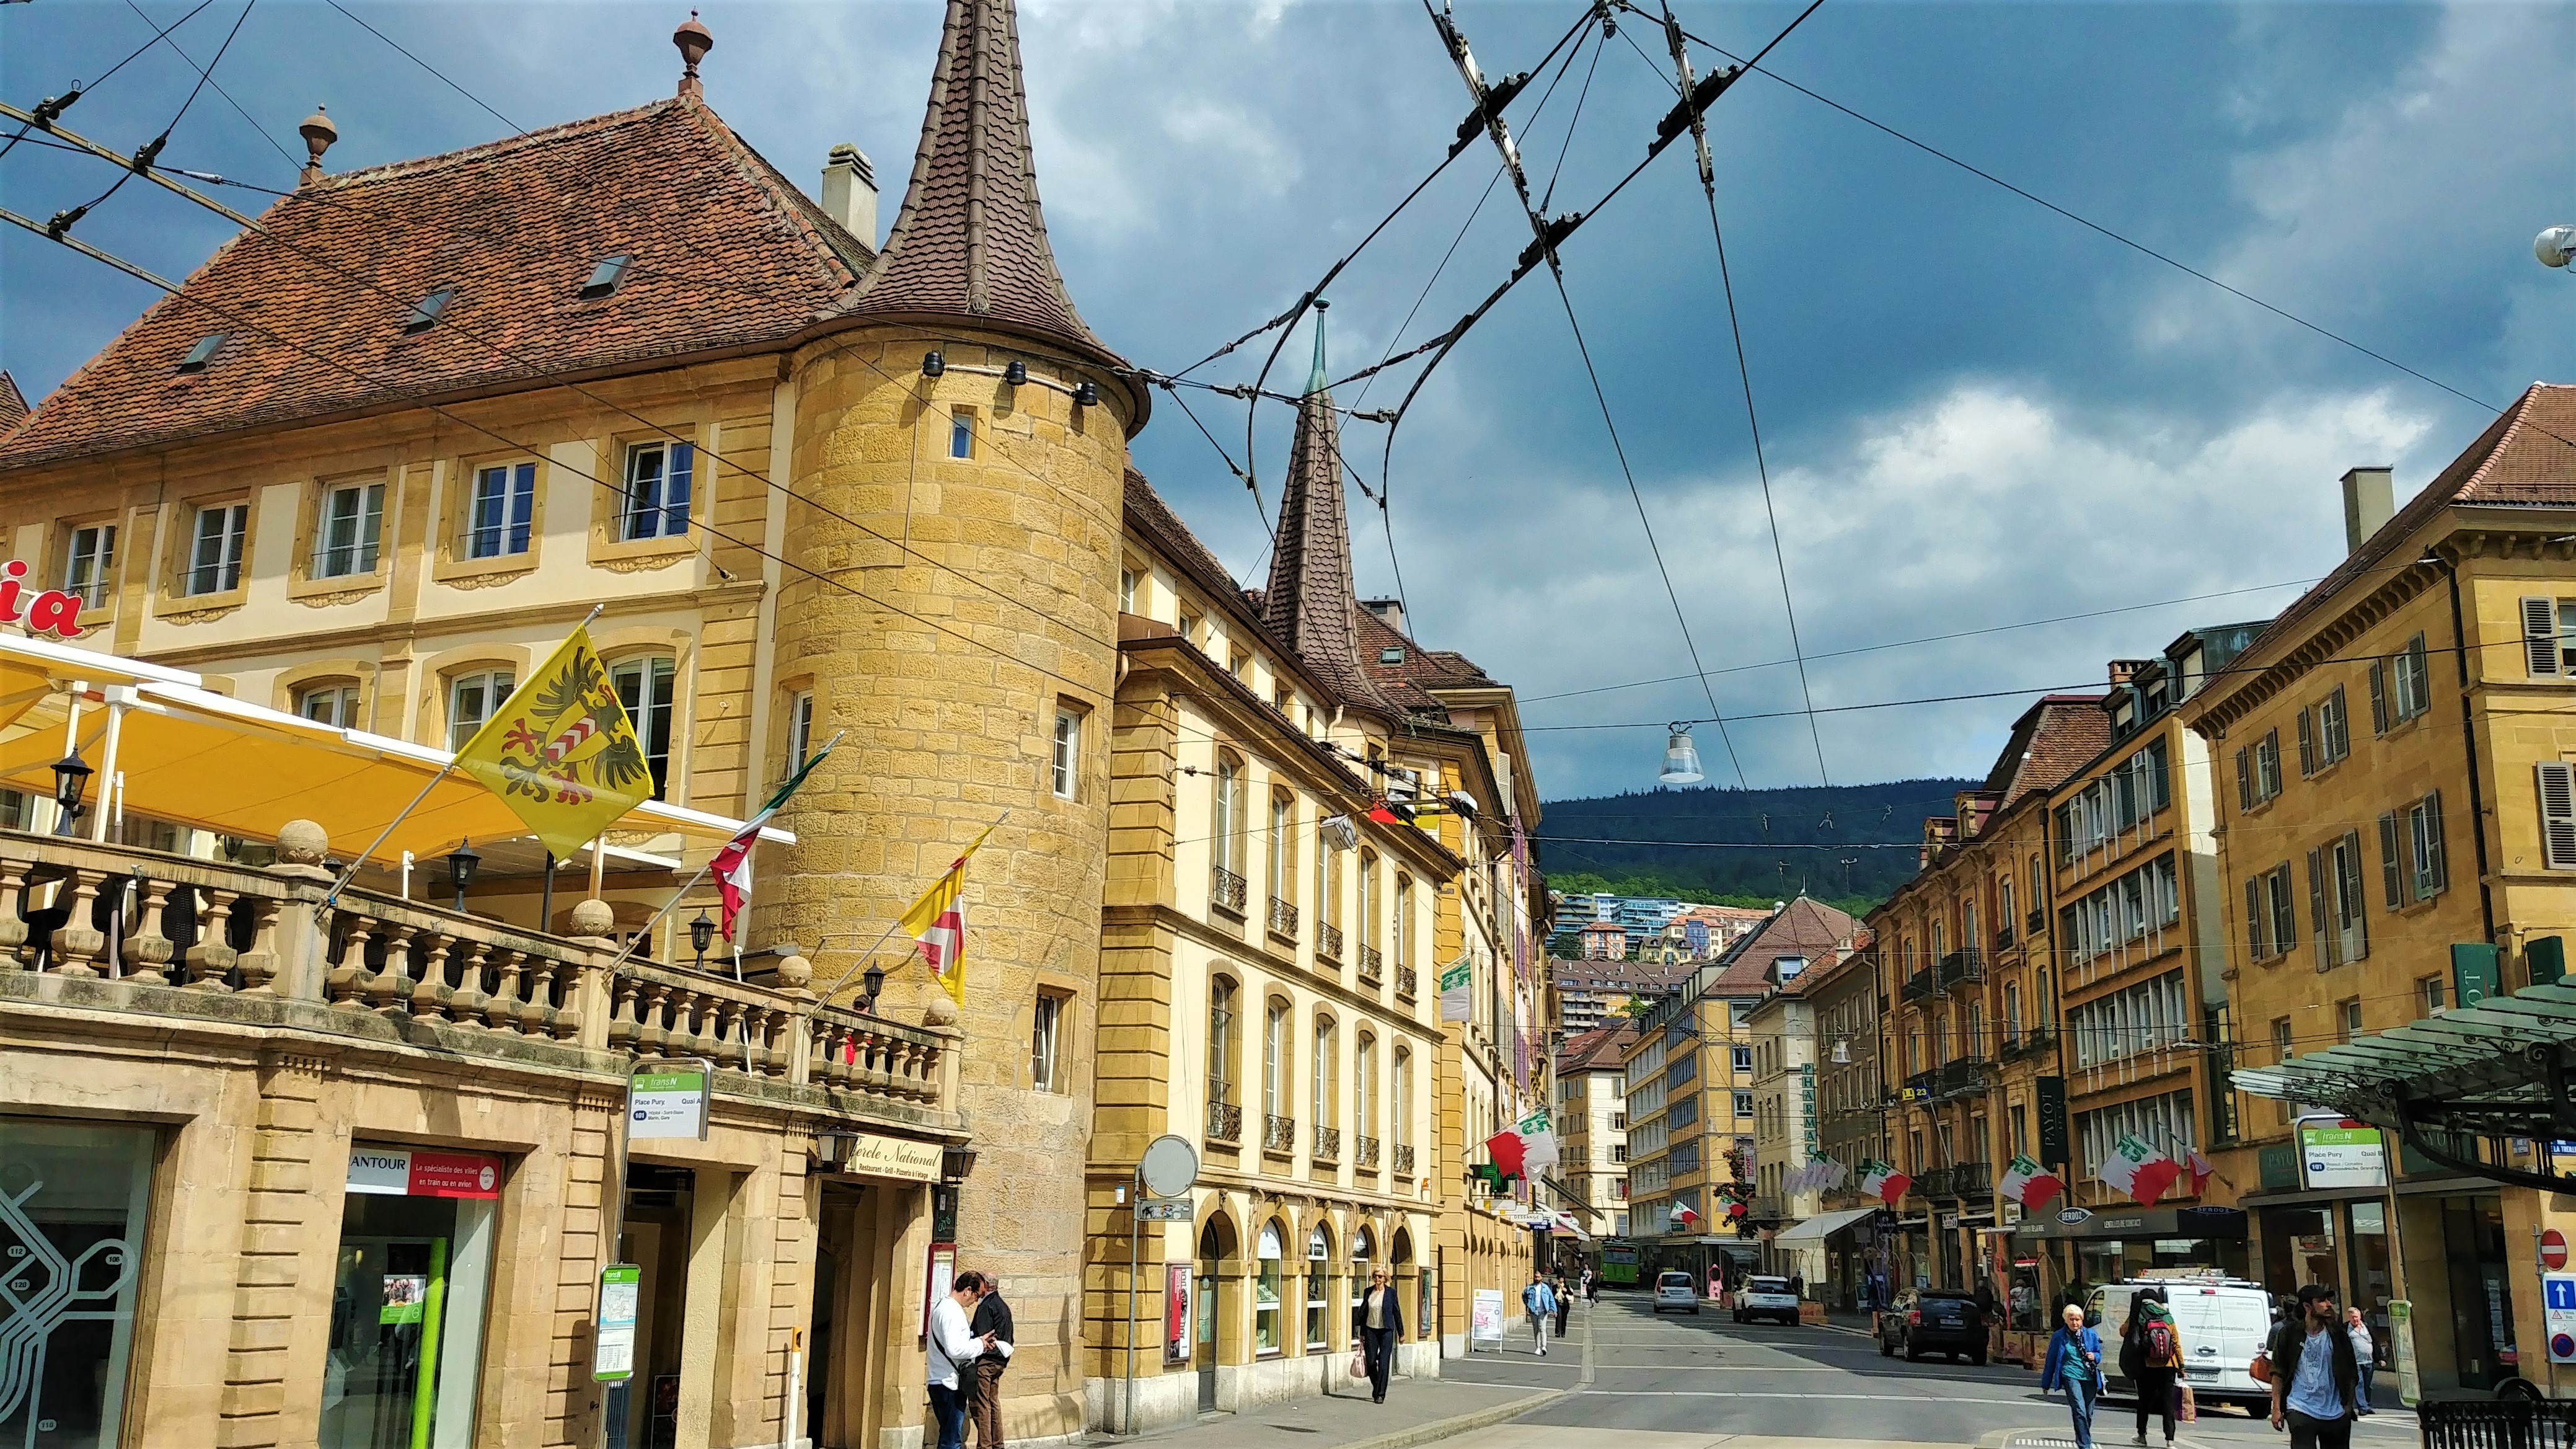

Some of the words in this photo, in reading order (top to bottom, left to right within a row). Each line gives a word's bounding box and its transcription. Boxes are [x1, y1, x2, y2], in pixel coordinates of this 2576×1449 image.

[1804, 1064, 1815, 1154] PHARMAC
[2042, 1092, 2055, 1146] PAYOT
[884, 1143, 942, 1167] National
[2269, 1151, 2294, 1168] PAYO
[350, 1156, 407, 1171] ANTOUR
[416, 1163, 423, 1171] Le
[424, 1164, 453, 1174] spécialiste
[464, 1167, 479, 1175] villes
[859, 1163, 882, 1172] Restaurant
[884, 1166, 894, 1174] Grill
[896, 1168, 912, 1177] Pizzeria
[419, 1179, 426, 1187] en
[427, 1178, 441, 1187] train
[457, 1180, 472, 1188] avion
[2062, 1211, 2083, 1221] BERDOZ
[2189, 1324, 2254, 1332] www.climatisation.ch
